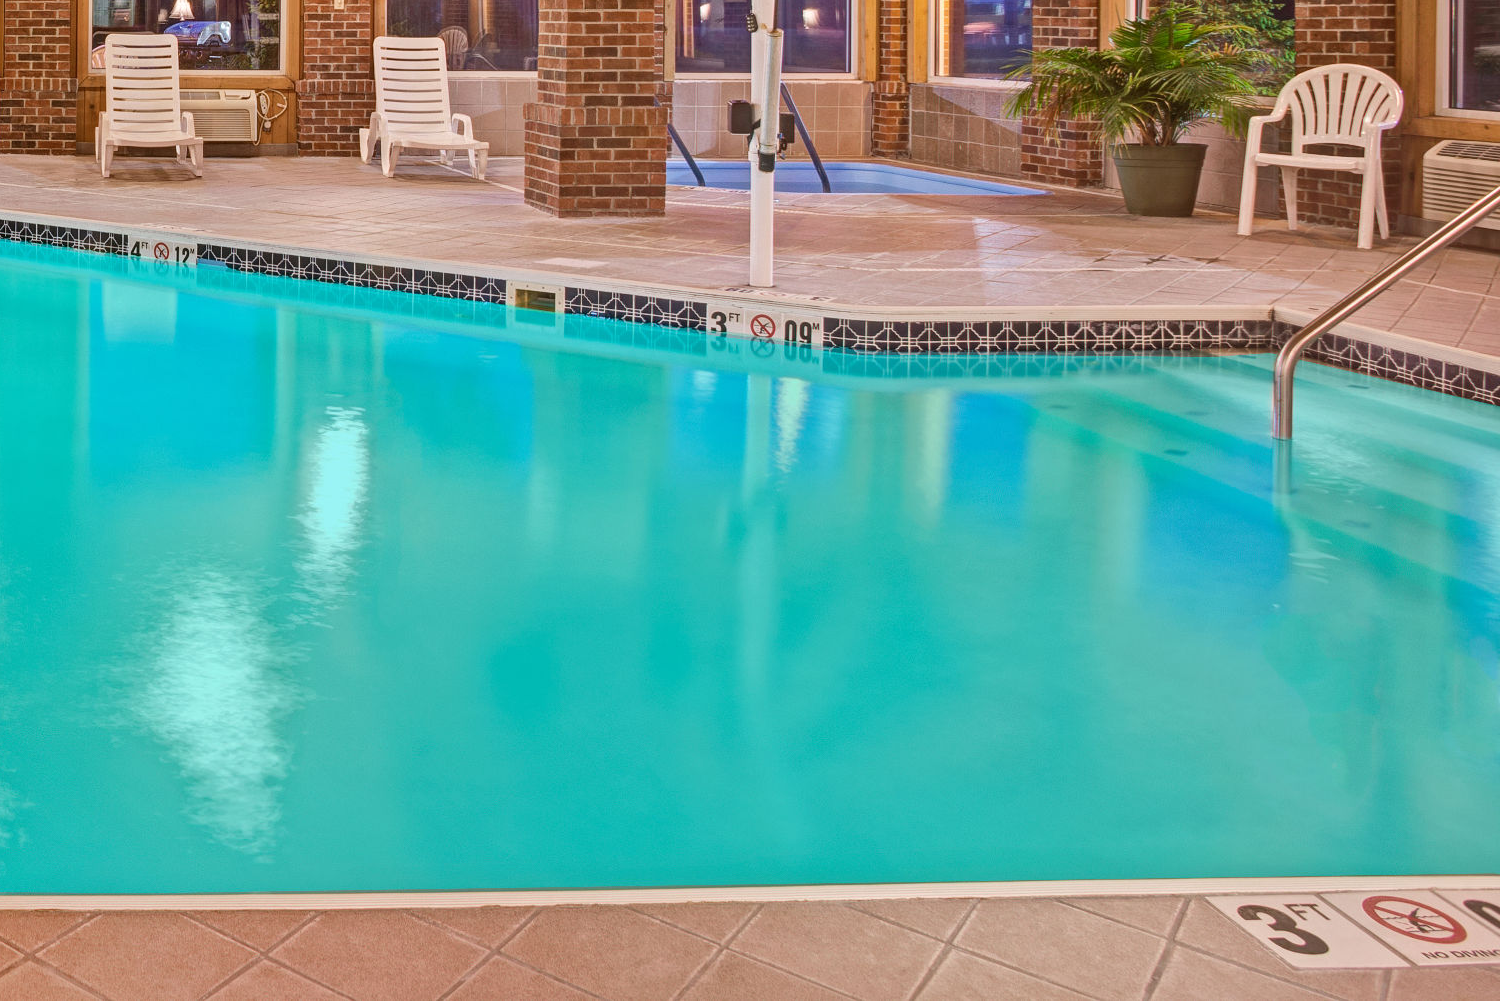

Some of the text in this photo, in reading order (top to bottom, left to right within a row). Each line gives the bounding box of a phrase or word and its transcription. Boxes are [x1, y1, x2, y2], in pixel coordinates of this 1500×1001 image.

[130, 241, 141, 256] 4
[710, 311, 727, 333] 3
[1237, 903, 1331, 955] 3 FT
[1421, 951, 1449, 959] NO
